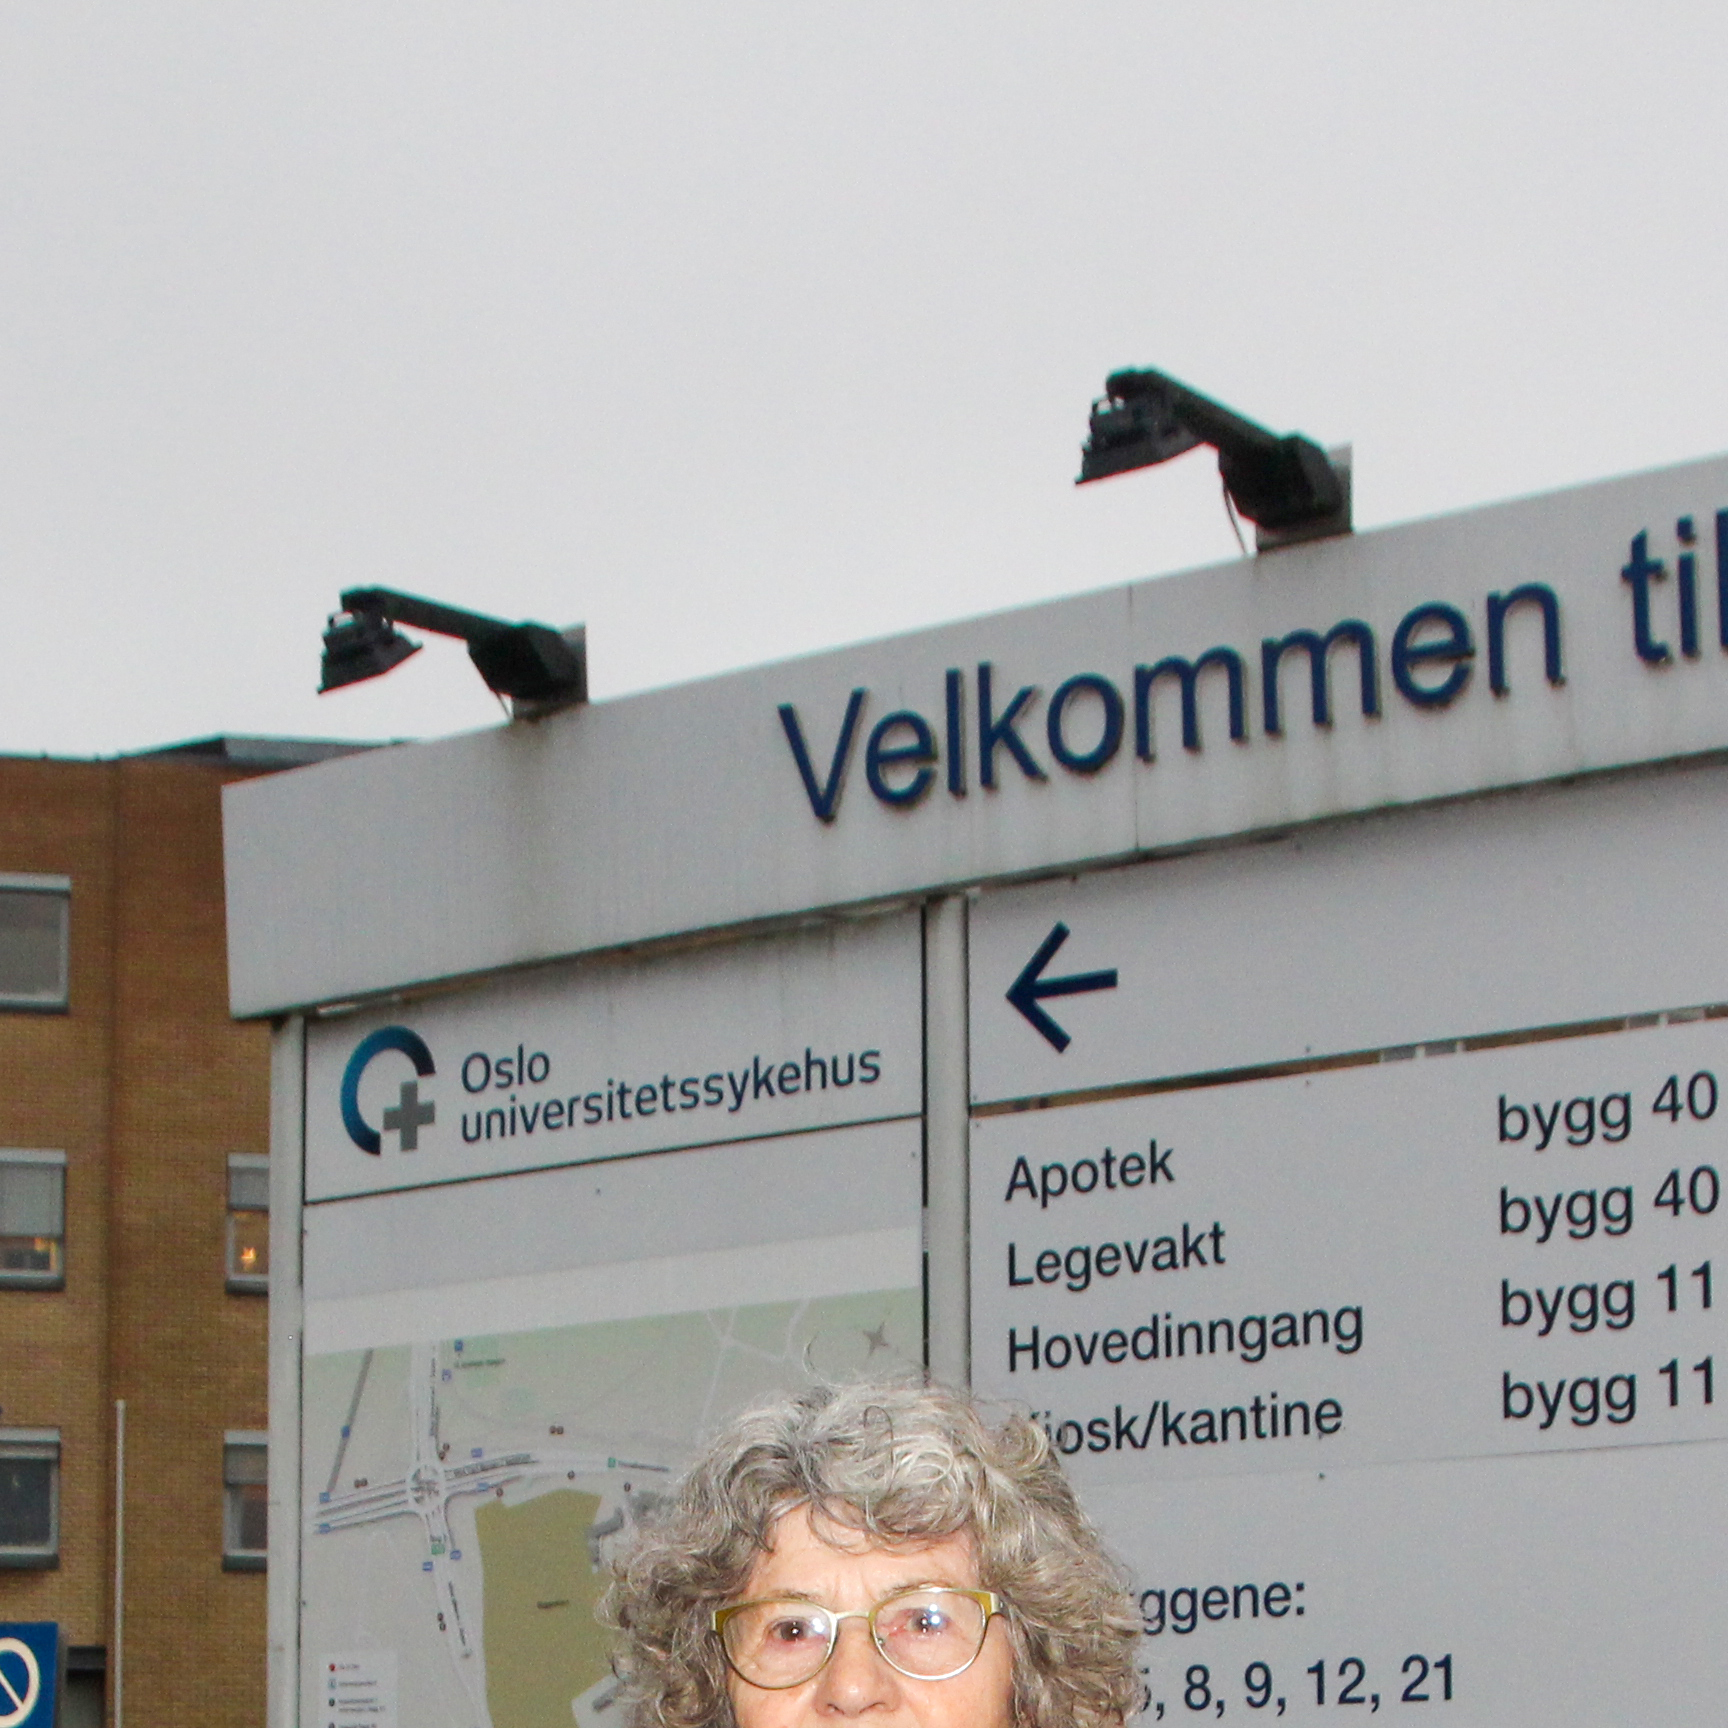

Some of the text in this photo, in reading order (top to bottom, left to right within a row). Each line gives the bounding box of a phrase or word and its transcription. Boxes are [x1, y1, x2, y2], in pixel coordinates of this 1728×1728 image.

[776, 582, 1568, 824] Velkommen
[461, 1043, 550, 1094] Oslo
[461, 1047, 881, 1144] universitetssykehus
[1004, 1070, 1718, 1210] Apotek bygg 40
[1008, 1165, 1720, 1292] Legevakt bygg 40
[1008, 1260, 1713, 1372] Hovedinngang bygg 11
[1031, 1356, 1714, 1455] iosk/kantine bygg 11
[1132, 1582, 1305, 1637] ggene:
[1183, 1664, 1225, 1719] 8,
[1244, 1661, 1286, 1717] 9,
[1307, 1657, 1380, 1714] 12,
[1401, 1653, 1454, 1703] 21
